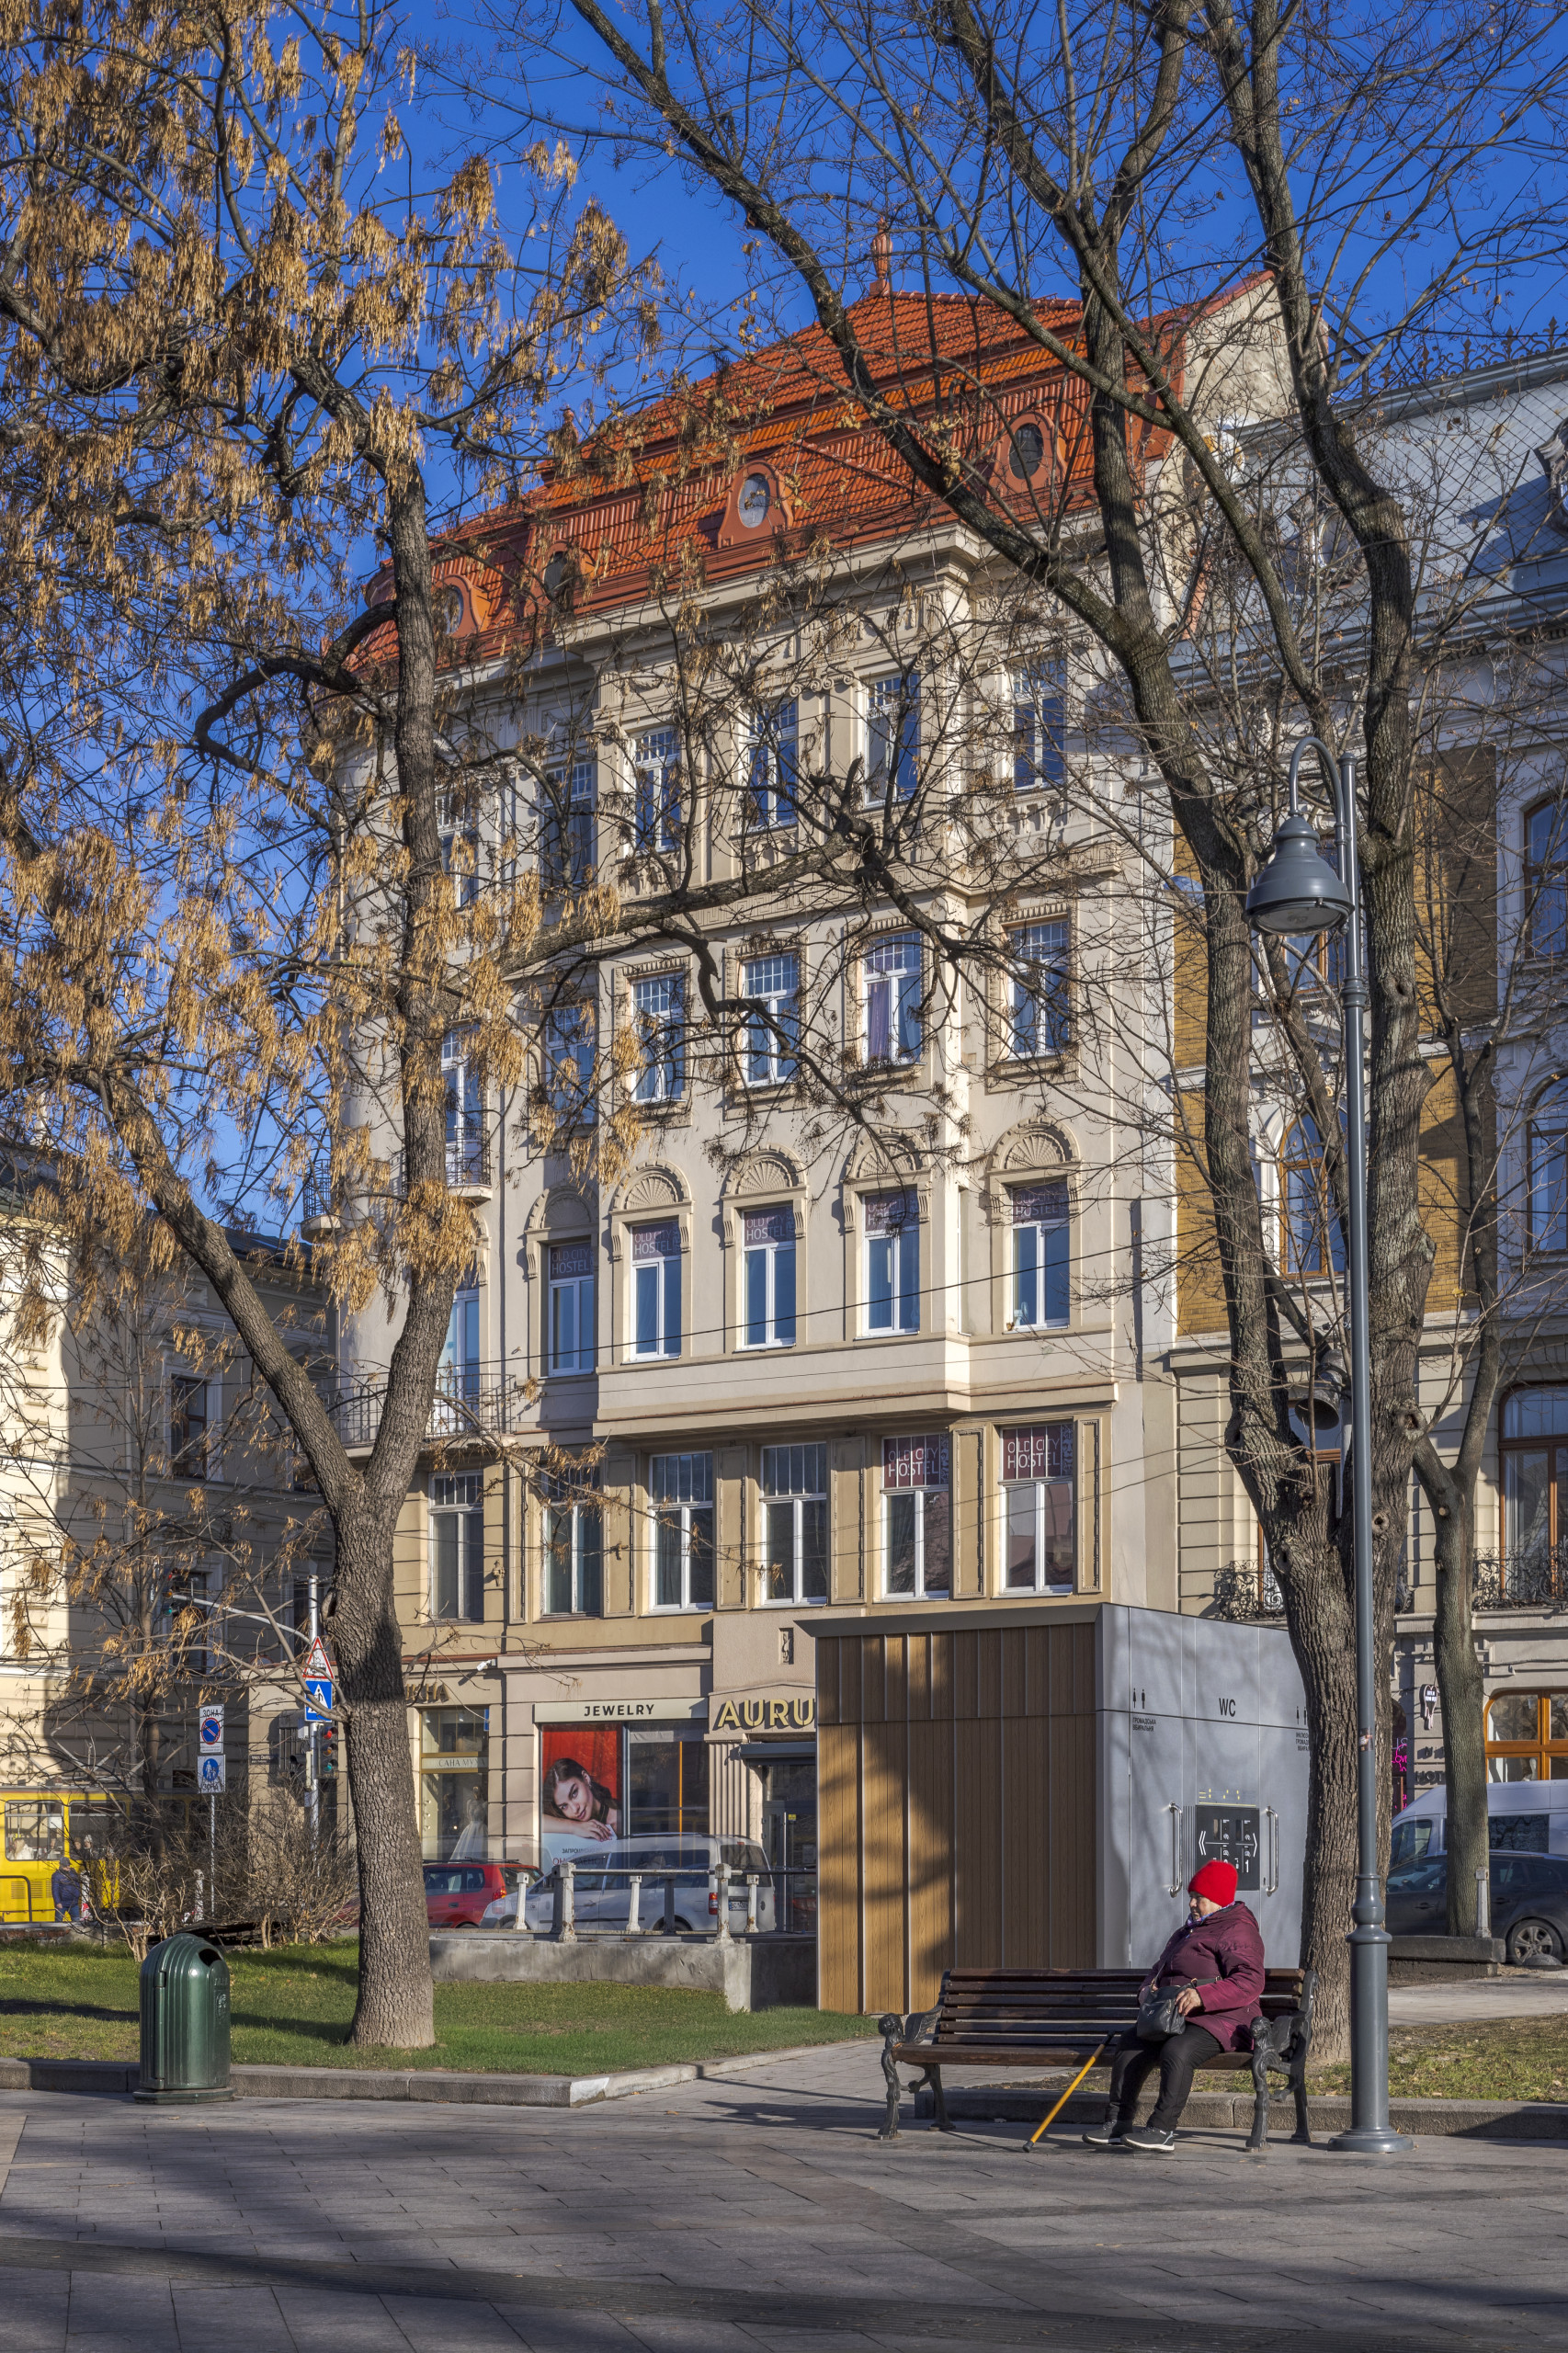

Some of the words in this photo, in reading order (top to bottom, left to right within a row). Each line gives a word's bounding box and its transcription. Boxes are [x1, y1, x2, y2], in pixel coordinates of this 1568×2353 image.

[1016, 1202, 1059, 1218] HOSTEL
[746, 1217, 765, 1229] OLD
[767, 1214, 787, 1227] CITY
[634, 1232, 652, 1243] OLD
[653, 1228, 673, 1241] CITY
[746, 1224, 786, 1241] HOSTEL
[551, 1251, 570, 1262] OLD
[571, 1248, 589, 1260] CITY
[634, 1238, 673, 1256] HOSTEL
[551, 1259, 589, 1275] HOSTEL
[1007, 1439, 1030, 1454] OLD
[1036, 1438, 1060, 1451] CITY
[888, 1449, 911, 1462] OLD
[915, 1447, 939, 1460] CITY
[1007, 1451, 1061, 1470] HOSTEL
[888, 1460, 939, 1478] HOSTEL
[202, 1709, 220, 1718] ЗОНА
[584, 1703, 654, 1717] JEWELRY
[718, 1698, 814, 1727] AURU
[1219, 1698, 1236, 1717] WC
[1415, 1770, 1444, 1783] HOT
